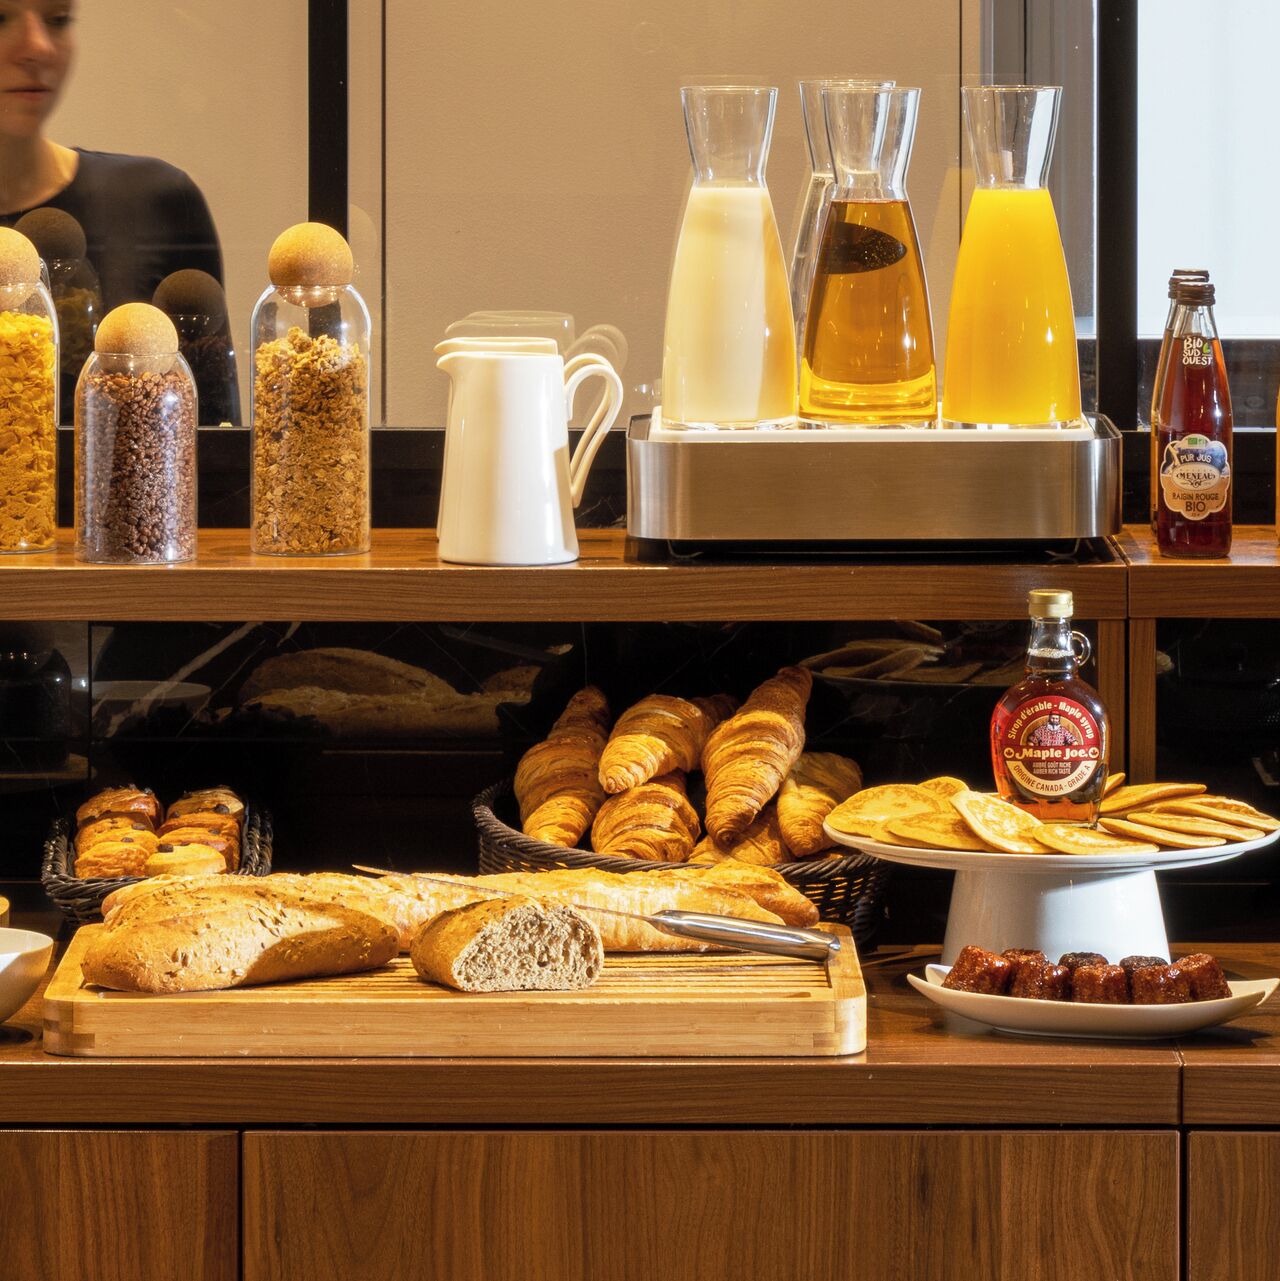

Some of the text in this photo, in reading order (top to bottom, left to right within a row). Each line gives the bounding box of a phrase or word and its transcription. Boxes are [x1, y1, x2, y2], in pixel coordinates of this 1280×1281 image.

[1183, 349, 1201, 357] SUD
[1182, 356, 1213, 366] OUEST
[1180, 454, 1212, 463] PUR JUS
[1172, 492, 1220, 501] RAISIN ROUGE
[1185, 501, 1206, 512] BIO
[1007, 701, 1095, 740] Sirop d'érable Maple syrup
[1015, 748, 1062, 760] Maple
[1013, 764, 1036, 788] ORIGINE
[1036, 782, 1064, 792] CANADA
[1067, 771, 1087, 788] GRADE
